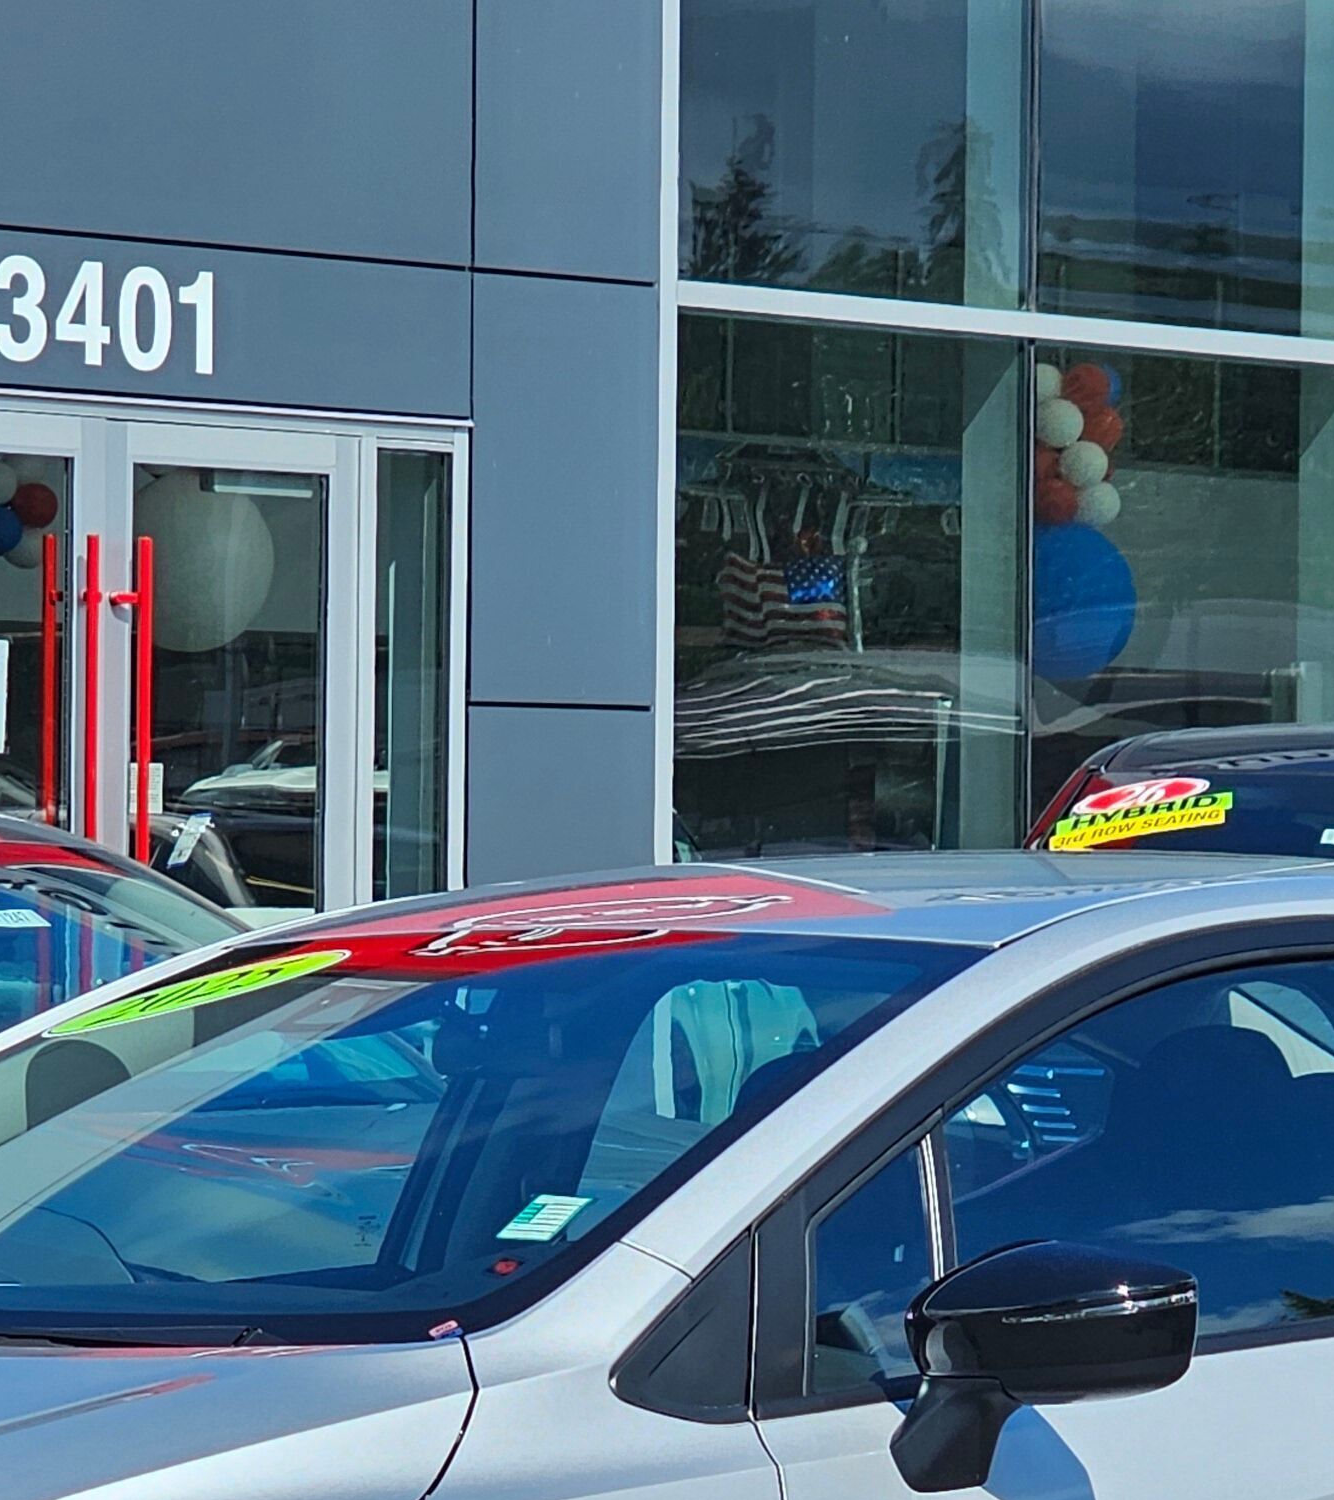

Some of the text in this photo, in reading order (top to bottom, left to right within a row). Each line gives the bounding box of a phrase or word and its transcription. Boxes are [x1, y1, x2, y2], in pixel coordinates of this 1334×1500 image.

[1071, 795, 1221, 831] HYBRID
[1091, 822, 1136, 839] ROW
[1140, 809, 1220, 829] SEATING
